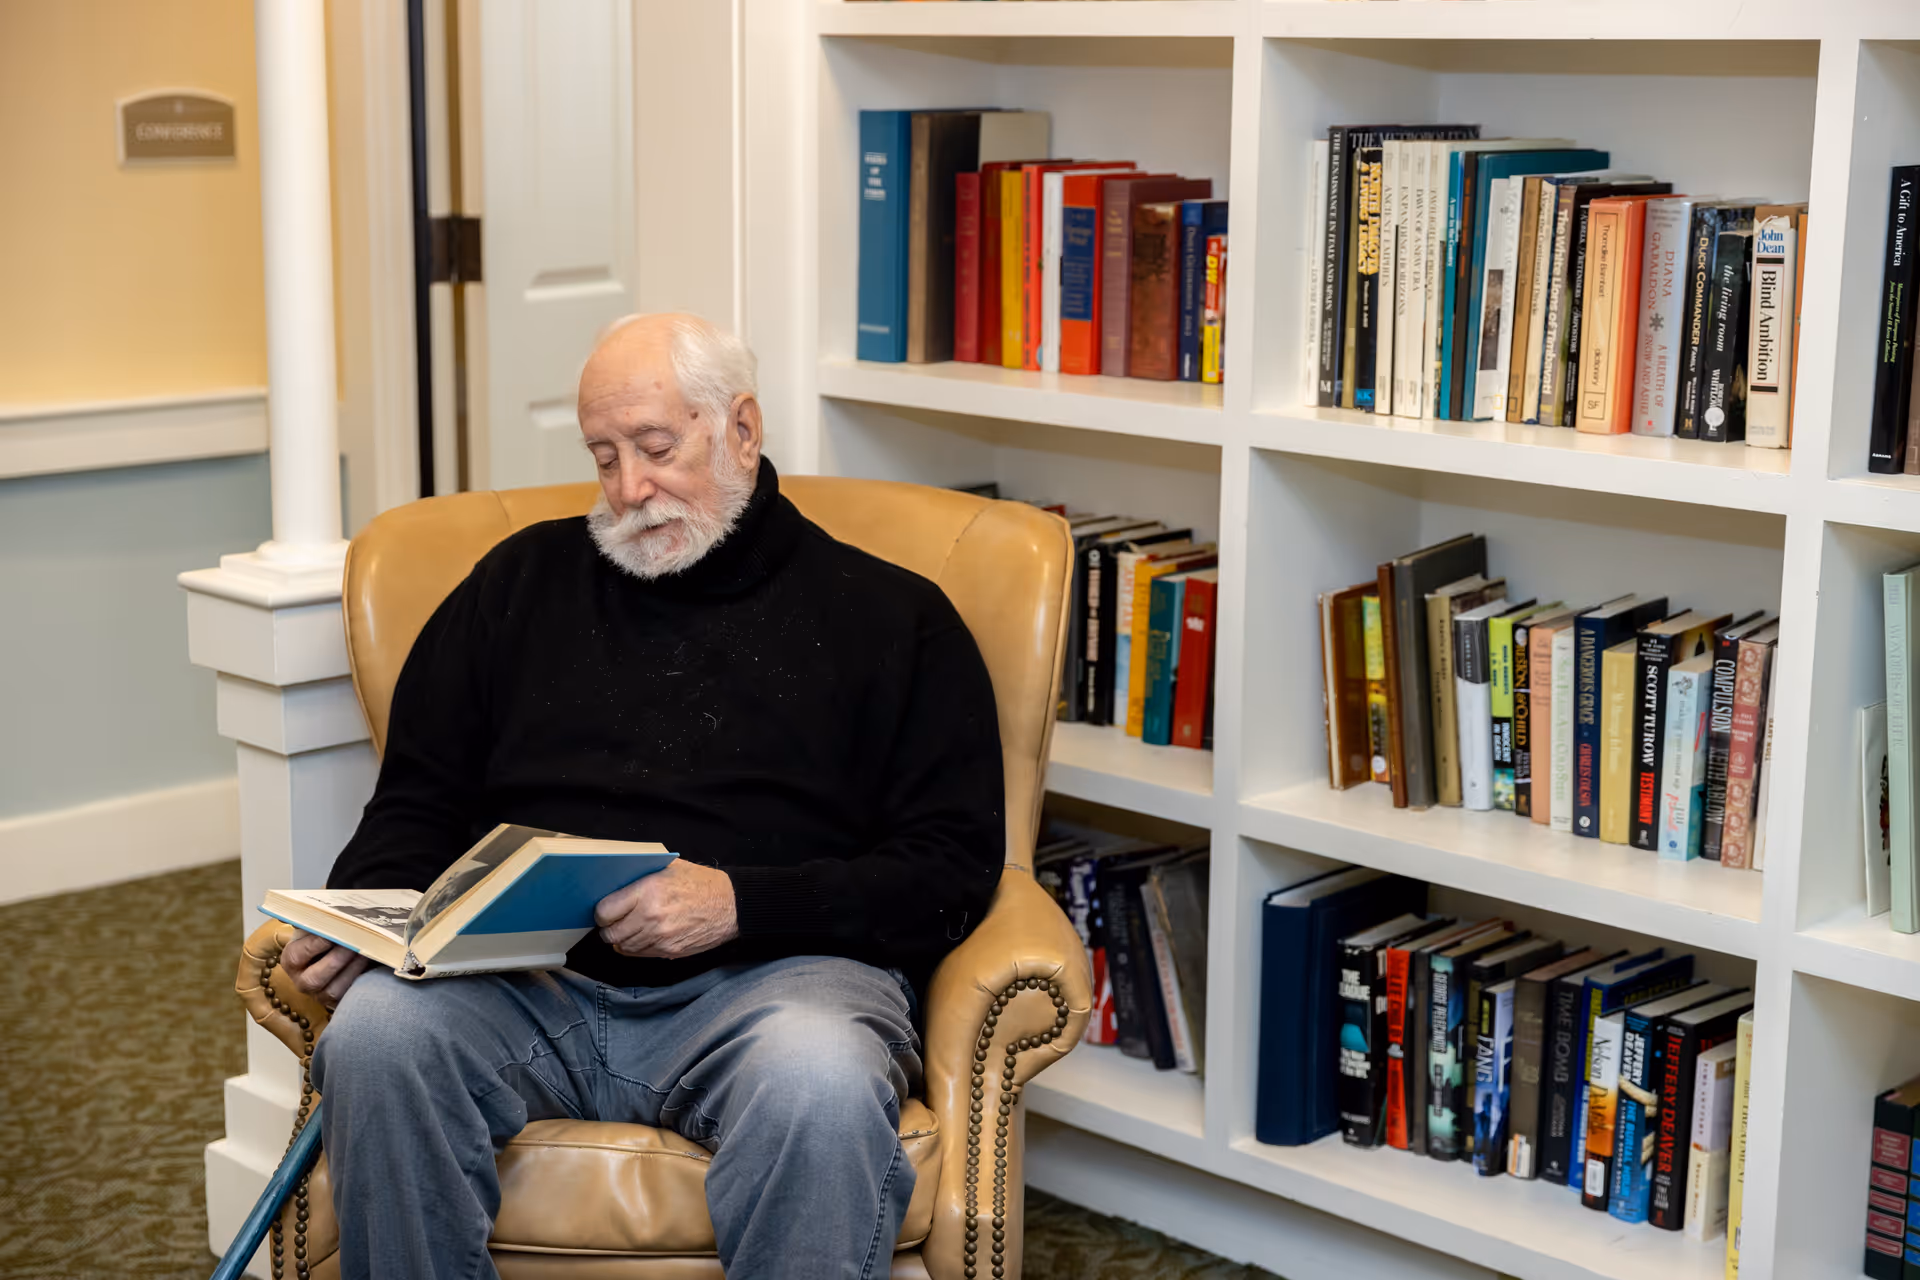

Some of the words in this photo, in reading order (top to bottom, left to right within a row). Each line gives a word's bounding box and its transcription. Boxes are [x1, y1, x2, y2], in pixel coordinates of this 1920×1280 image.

[1333, 132, 1342, 153] THE
[1329, 154, 1340, 217] RENAISSANCE
[1360, 161, 1370, 173] A
[1901, 179, 1912, 187] A
[1358, 175, 1370, 221] LIVING
[1369, 162, 1382, 214] NORTH
[1416, 188, 1424, 219] DAWN
[1898, 189, 1911, 209] Gift
[1329, 220, 1337, 230] IN
[1383, 185, 1393, 233] ANCIENT
[1400, 186, 1409, 255] EXPANDING
[1557, 208, 1569, 235] The
[1898, 213, 1907, 224] to
[1327, 232, 1337, 260] ITALY
[1357, 224, 1369, 275] LEGACY
[1366, 215, 1381, 276] DAKOTA
[1697, 237, 1709, 270] DUCK
[1757, 242, 1785, 254] Dean
[1758, 229, 1784, 242] John
[1893, 225, 1909, 267] America
[1326, 263, 1335, 283] AND
[1382, 238, 1391, 288] EMPIRES
[1553, 236, 1567, 276] White
[1647, 232, 1661, 311] GABALDON
[1662, 250, 1676, 298] DIANA
[1723, 264, 1735, 284] the
[1325, 285, 1333, 310] SPAIN
[1412, 271, 1420, 292] ERA
[1550, 277, 1563, 313] Lions
[1760, 270, 1777, 309] Blind
[1549, 313, 1559, 330] of
[1691, 271, 1706, 345] COMMANDER
[1716, 286, 1733, 321] living
[1716, 322, 1727, 352] room
[1756, 311, 1775, 381] Ambition
[1542, 330, 1558, 395] Timbavati
[1592, 348, 1603, 386] dictionary
[1655, 354, 1668, 391] BREATH
[1690, 346, 1698, 373] FAMILY
[1588, 400, 1600, 410] SF
[1655, 394, 1664, 408] OF
[1580, 627, 1596, 636] A
[1579, 636, 1596, 693] DANGEROUS
[1644, 665, 1659, 712] SCOTT
[1711, 659, 1736, 734] COMPULSION
[1577, 693, 1594, 726] GRACE
[1493, 723, 1501, 734] IN
[1501, 722, 1512, 764] INNOCENT
[1641, 713, 1656, 767] TUROW
[1493, 734, 1502, 762] DEATH
[1580, 743, 1593, 776] CHARLES
[1708, 747, 1729, 780] KEITH
[1579, 776, 1592, 808] COLSON
[1637, 772, 1655, 826] TESTIMONY
[1705, 783, 1726, 825] ABLOW
[1556, 990, 1574, 1027] TIME
[1476, 1035, 1496, 1083] FANG
[1553, 1030, 1572, 1083] BOMB
[1591, 1038, 1613, 1080] Nelson
[1622, 1031, 1635, 1080] DEAVER
[1631, 1033, 1646, 1086] JEFFERY
[1664, 1035, 1684, 1107] JEFFERY
[1590, 1082, 1610, 1136] DeMille
[1626, 1100, 1638, 1121] THE
[1623, 1122, 1636, 1163] BURIAL
[1657, 1108, 1677, 1173] DEAVER
